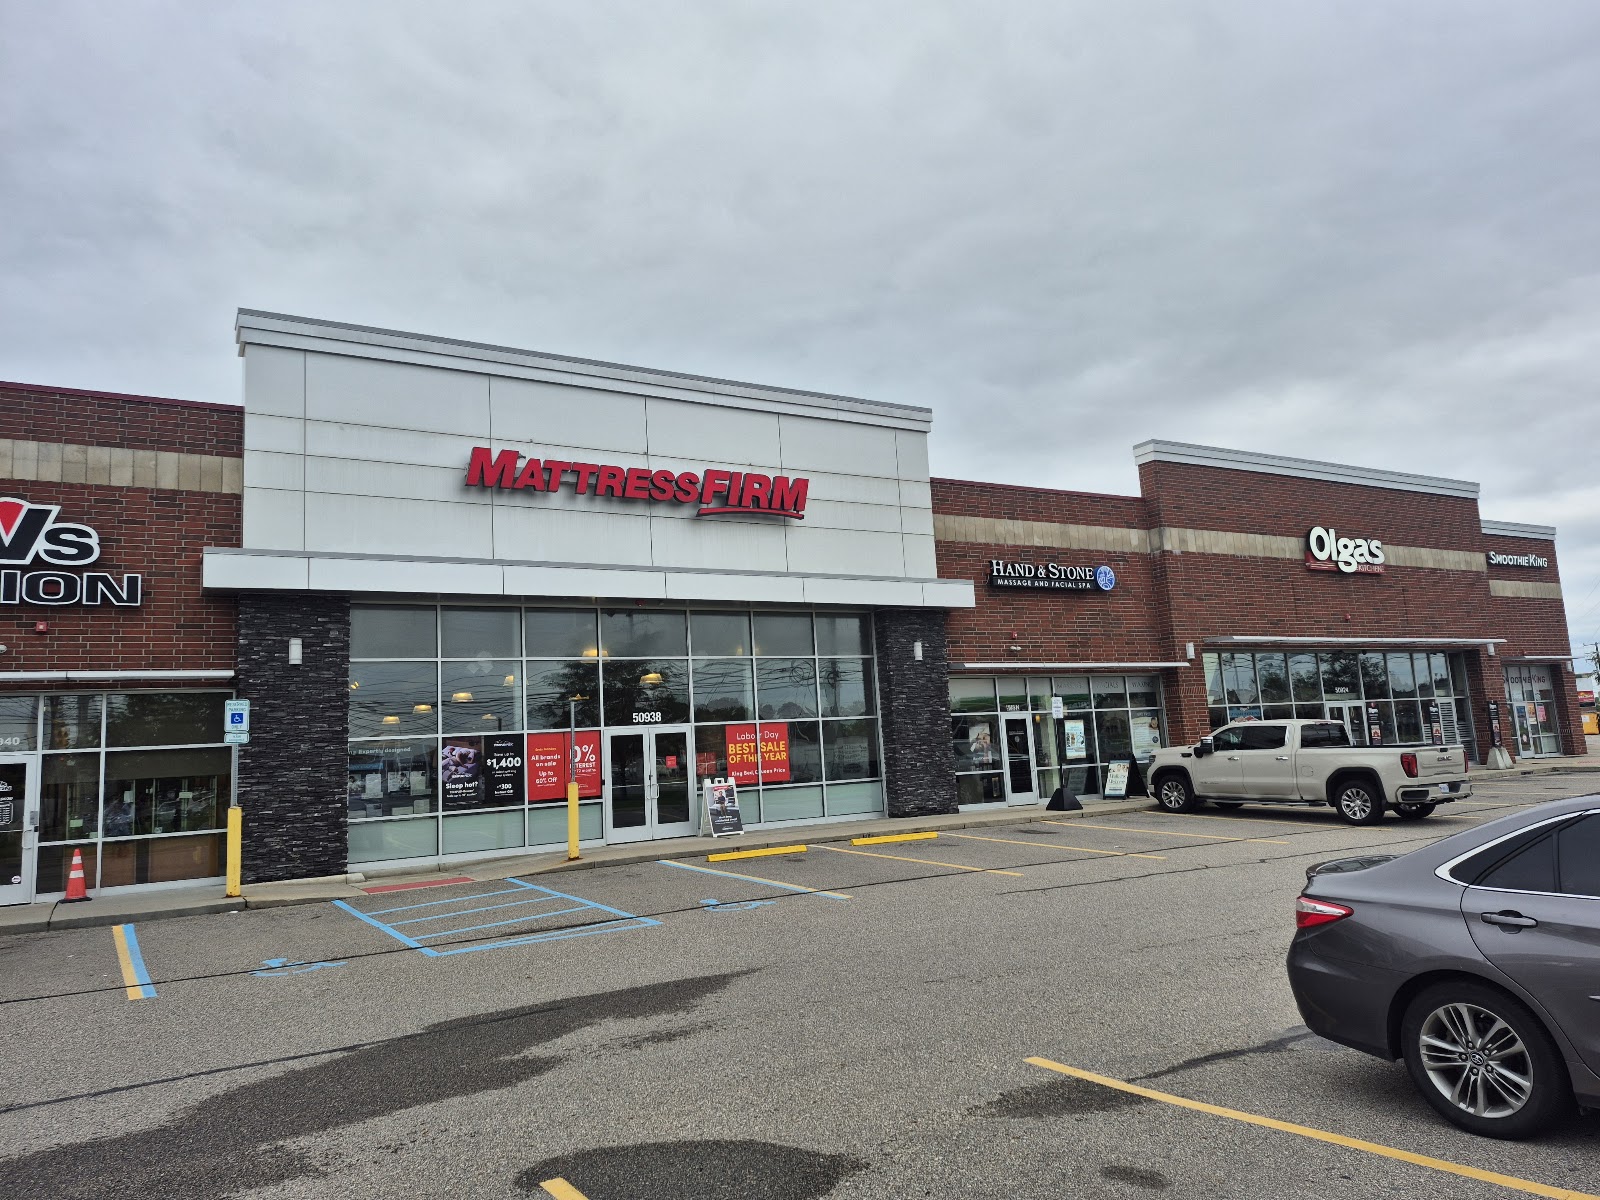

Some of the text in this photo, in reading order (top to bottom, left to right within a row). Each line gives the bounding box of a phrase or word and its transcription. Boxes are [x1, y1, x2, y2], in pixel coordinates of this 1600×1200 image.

[992, 560, 1095, 580] HAND & STONE
[632, 711, 661, 723] 50938
[764, 731, 779, 740] Day
[728, 741, 786, 754] BEST SALE
[486, 757, 522, 770] $1,400
[729, 752, 787, 764] OF THE YEAR
